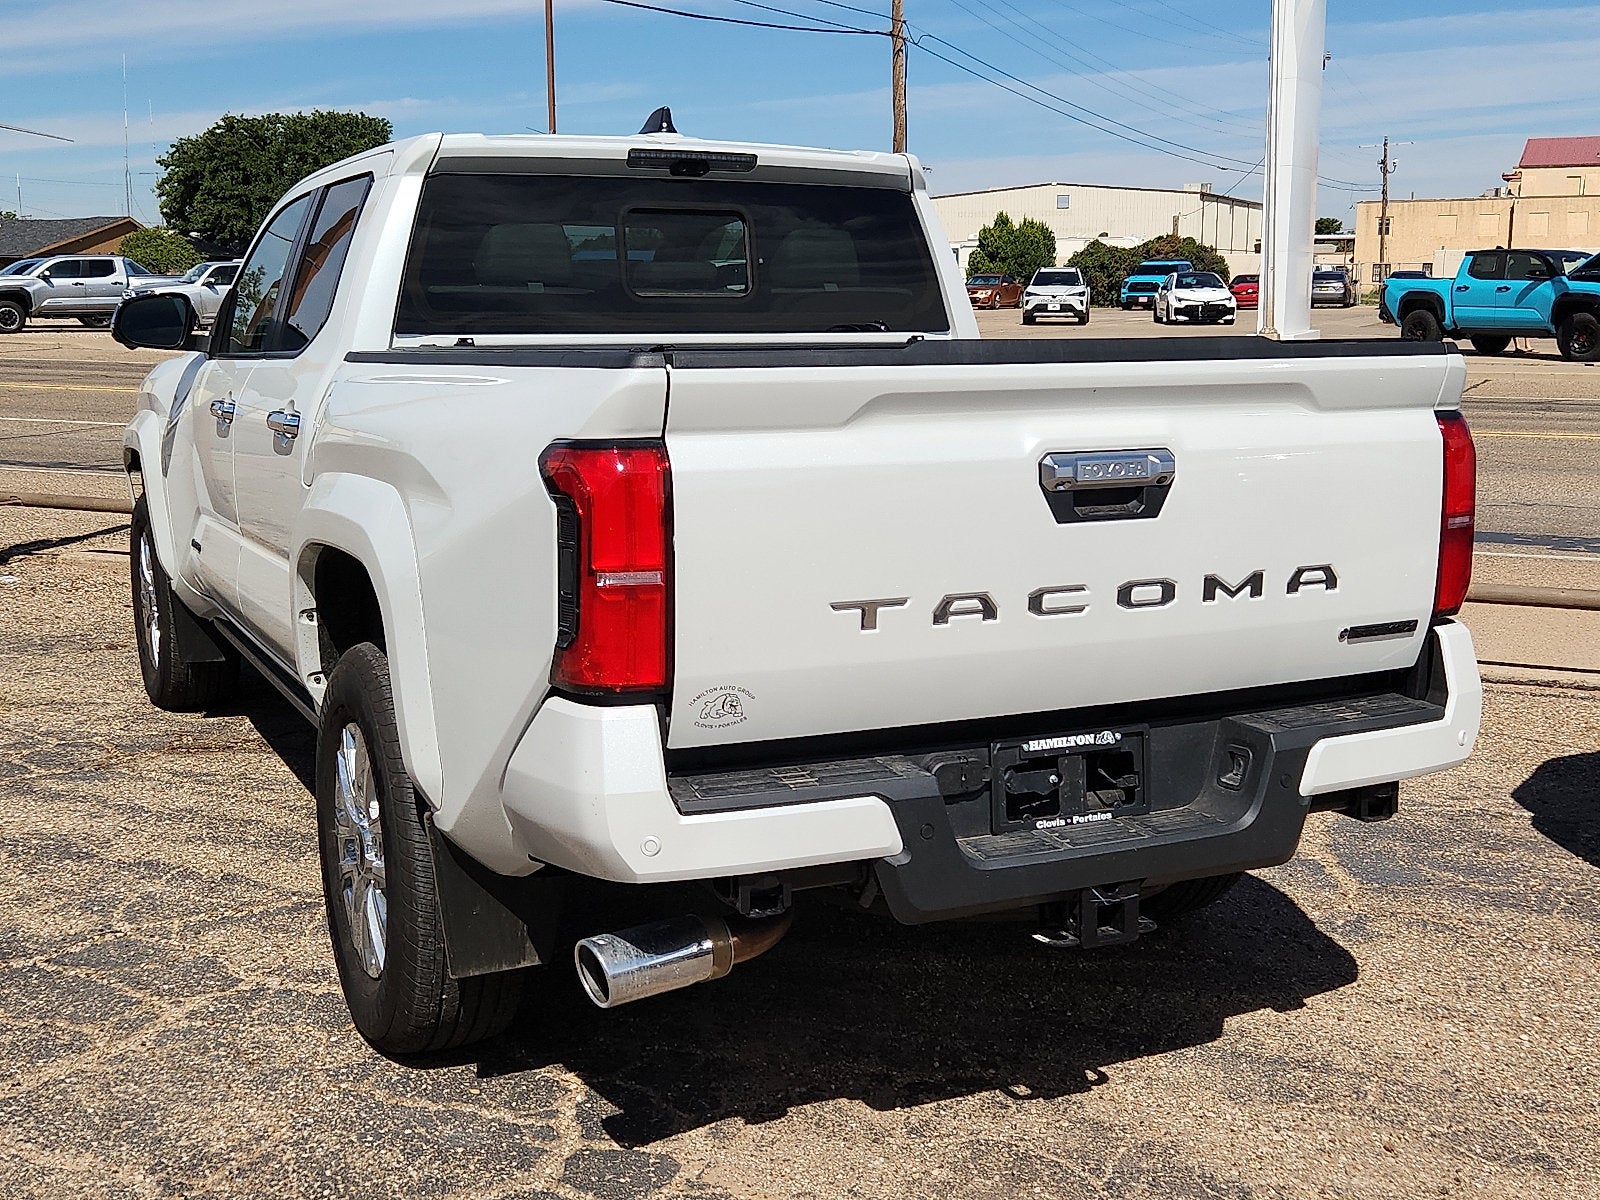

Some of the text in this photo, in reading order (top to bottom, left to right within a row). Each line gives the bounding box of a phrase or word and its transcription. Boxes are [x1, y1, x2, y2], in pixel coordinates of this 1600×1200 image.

[1080, 462, 1147, 477] TOYOTA
[829, 563, 1341, 631] TACOMA
[688, 687, 718, 707] HAMILTON
[737, 686, 756, 700] GROUP
[1028, 734, 1095, 751] HAMILTON
[1036, 812, 1112, 829] Clovis Portales
